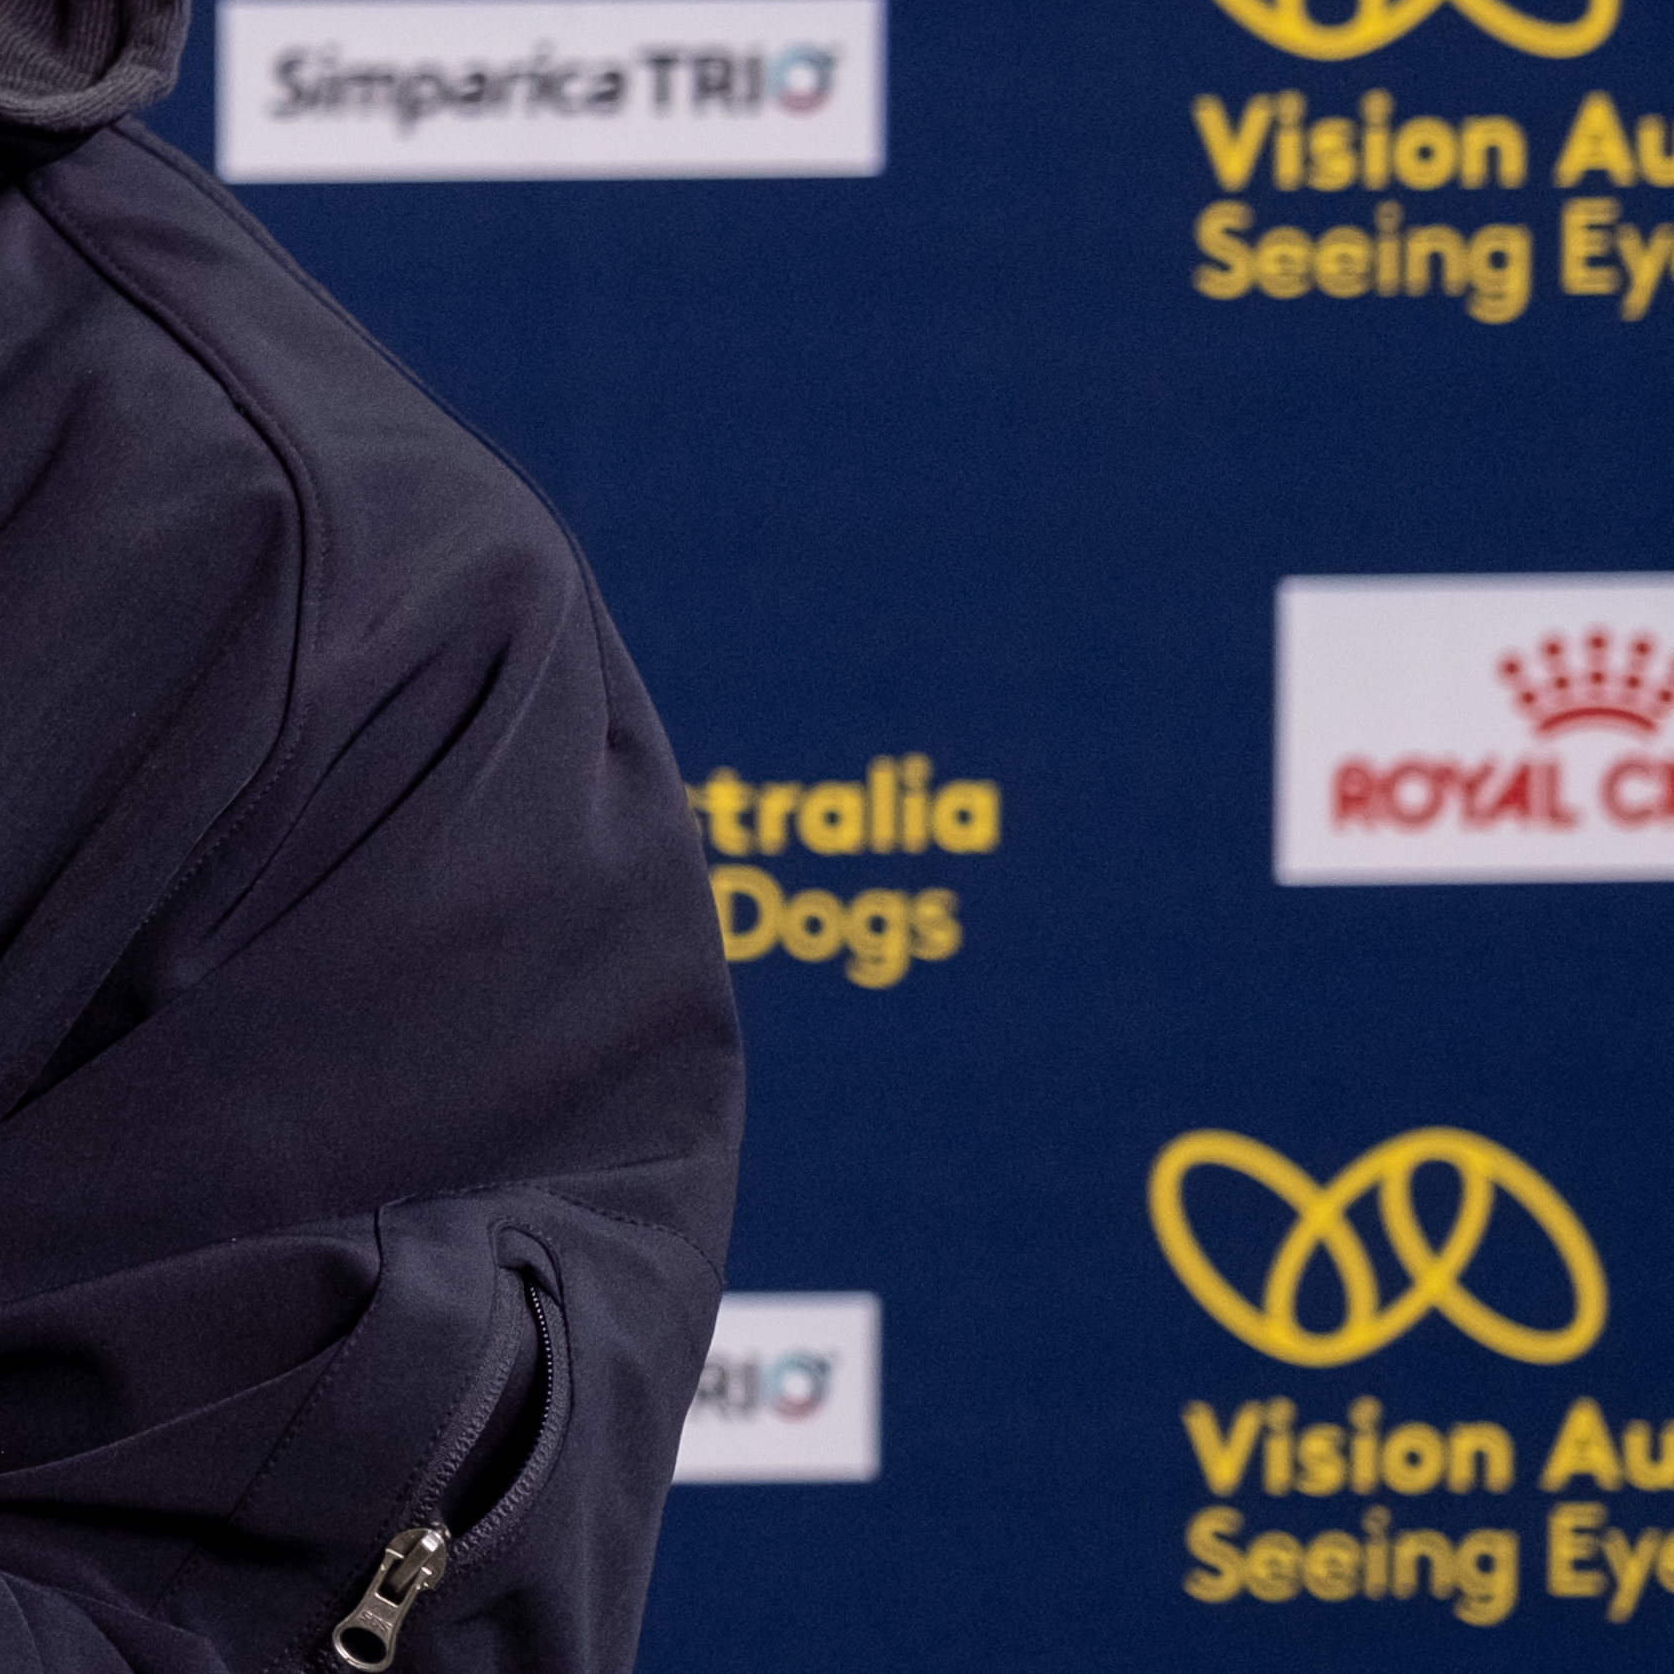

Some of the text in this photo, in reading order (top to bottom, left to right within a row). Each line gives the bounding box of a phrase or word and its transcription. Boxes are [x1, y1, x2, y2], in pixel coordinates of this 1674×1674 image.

[1193, 90, 1527, 193] Vision
[1195, 197, 1674, 324] Seeing Ey
[682, 750, 1000, 856] tralia
[1329, 757, 1580, 832] ROYAL
[708, 862, 962, 990] Dogs
[1183, 1397, 1514, 1496] Vision
[1184, 1504, 1519, 1626] Seeing
